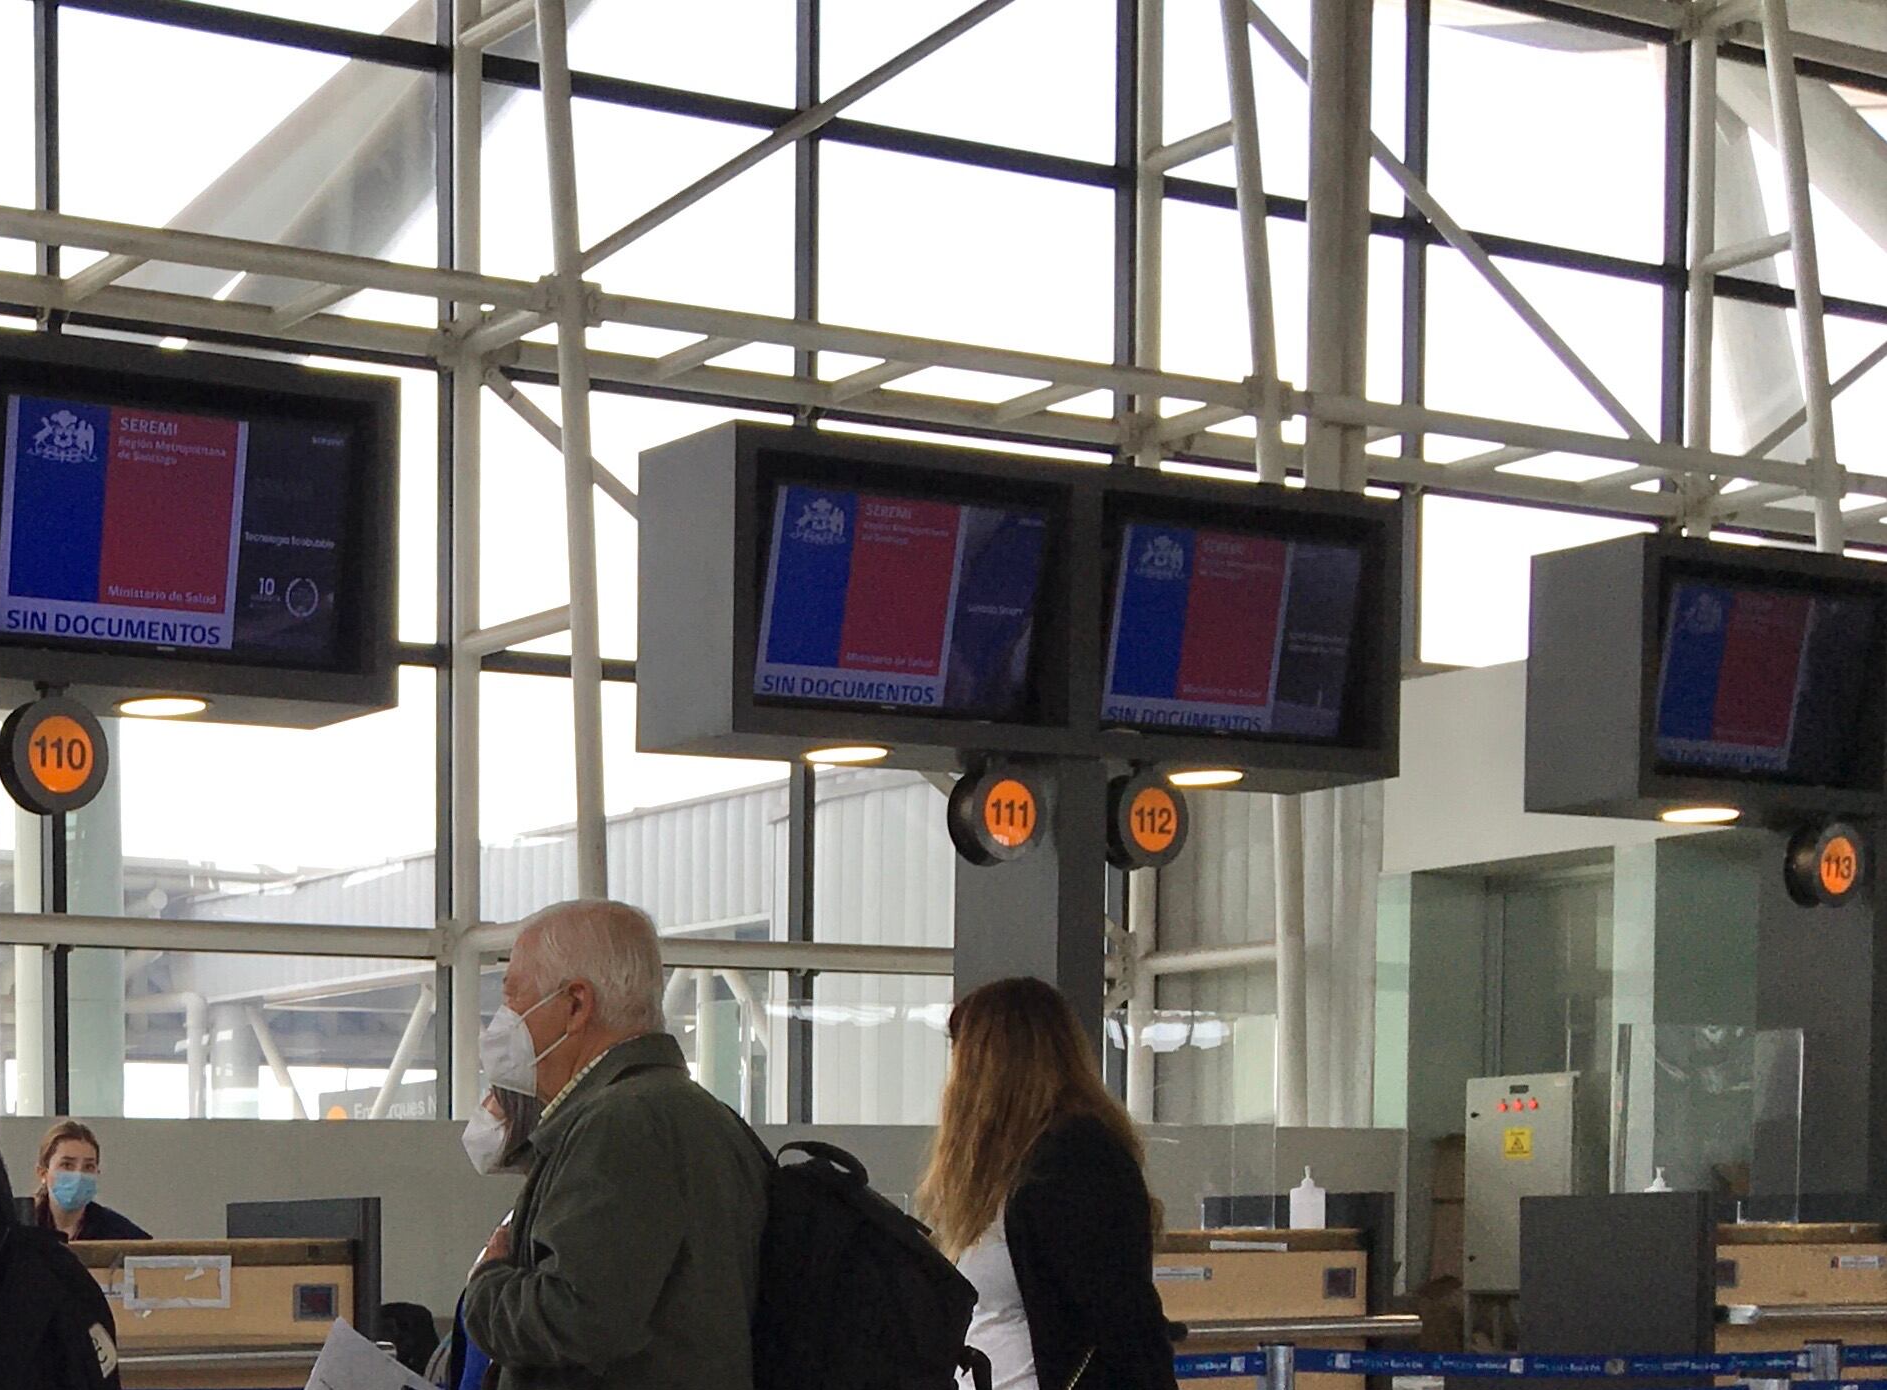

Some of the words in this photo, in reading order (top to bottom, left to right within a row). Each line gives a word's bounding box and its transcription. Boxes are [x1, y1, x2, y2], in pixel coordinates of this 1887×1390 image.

[120, 417, 177, 435] SEREMI
[107, 585, 166, 602] Ministerio
[7, 609, 46, 632] SIN
[54, 613, 220, 645] DOCUMENTOS
[763, 675, 795, 694] SIN
[801, 677, 934, 703] DOCUMENTOS
[33, 736, 86, 770] 110
[991, 798, 1029, 828] 111
[1134, 807, 1172, 835] 112
[1824, 854, 1853, 880] 113
